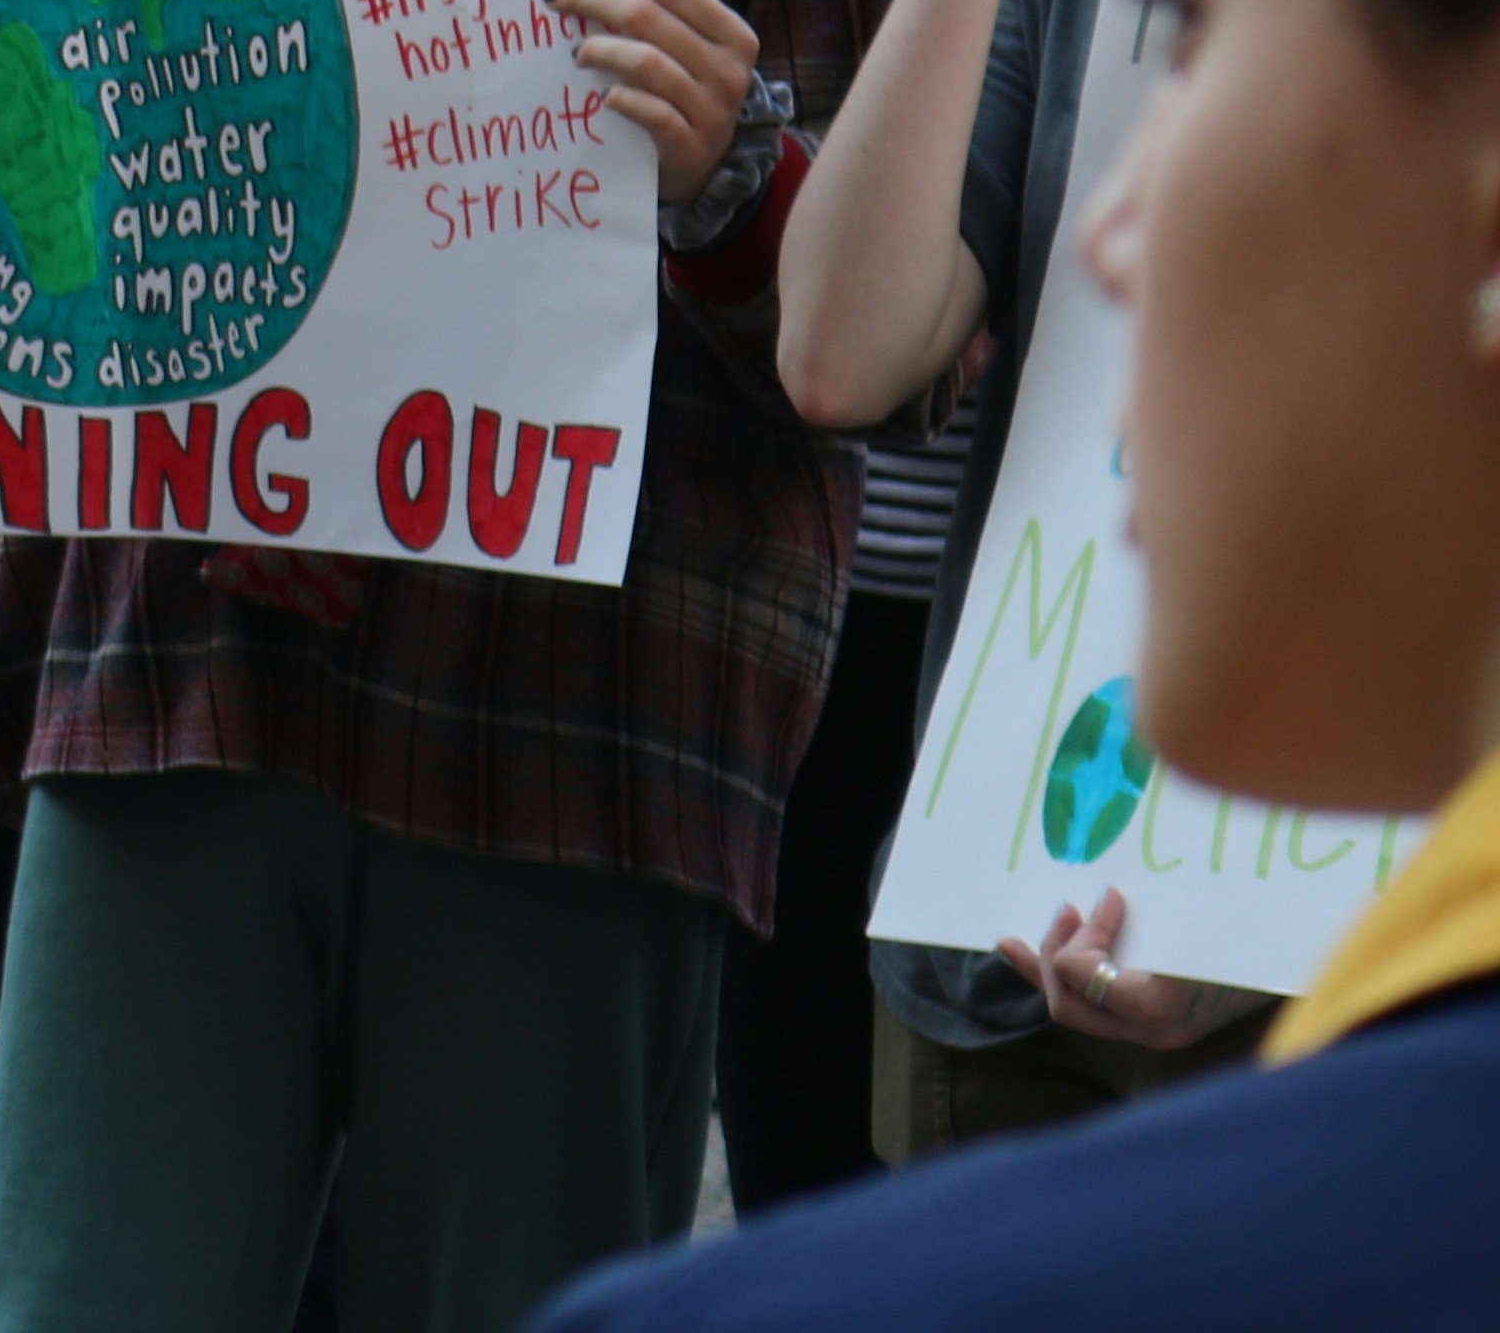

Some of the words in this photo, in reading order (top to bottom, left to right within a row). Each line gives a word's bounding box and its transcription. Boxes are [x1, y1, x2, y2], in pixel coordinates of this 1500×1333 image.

[60, 19, 136, 71] air
[100, 20, 307, 140] pollution
[110, 105, 272, 190] water
[383, 84, 605, 171] #climate
[113, 181, 295, 265] quality
[114, 255, 307, 334] impacts
[99, 312, 264, 388] disaster
[376, 388, 622, 564] OUT
